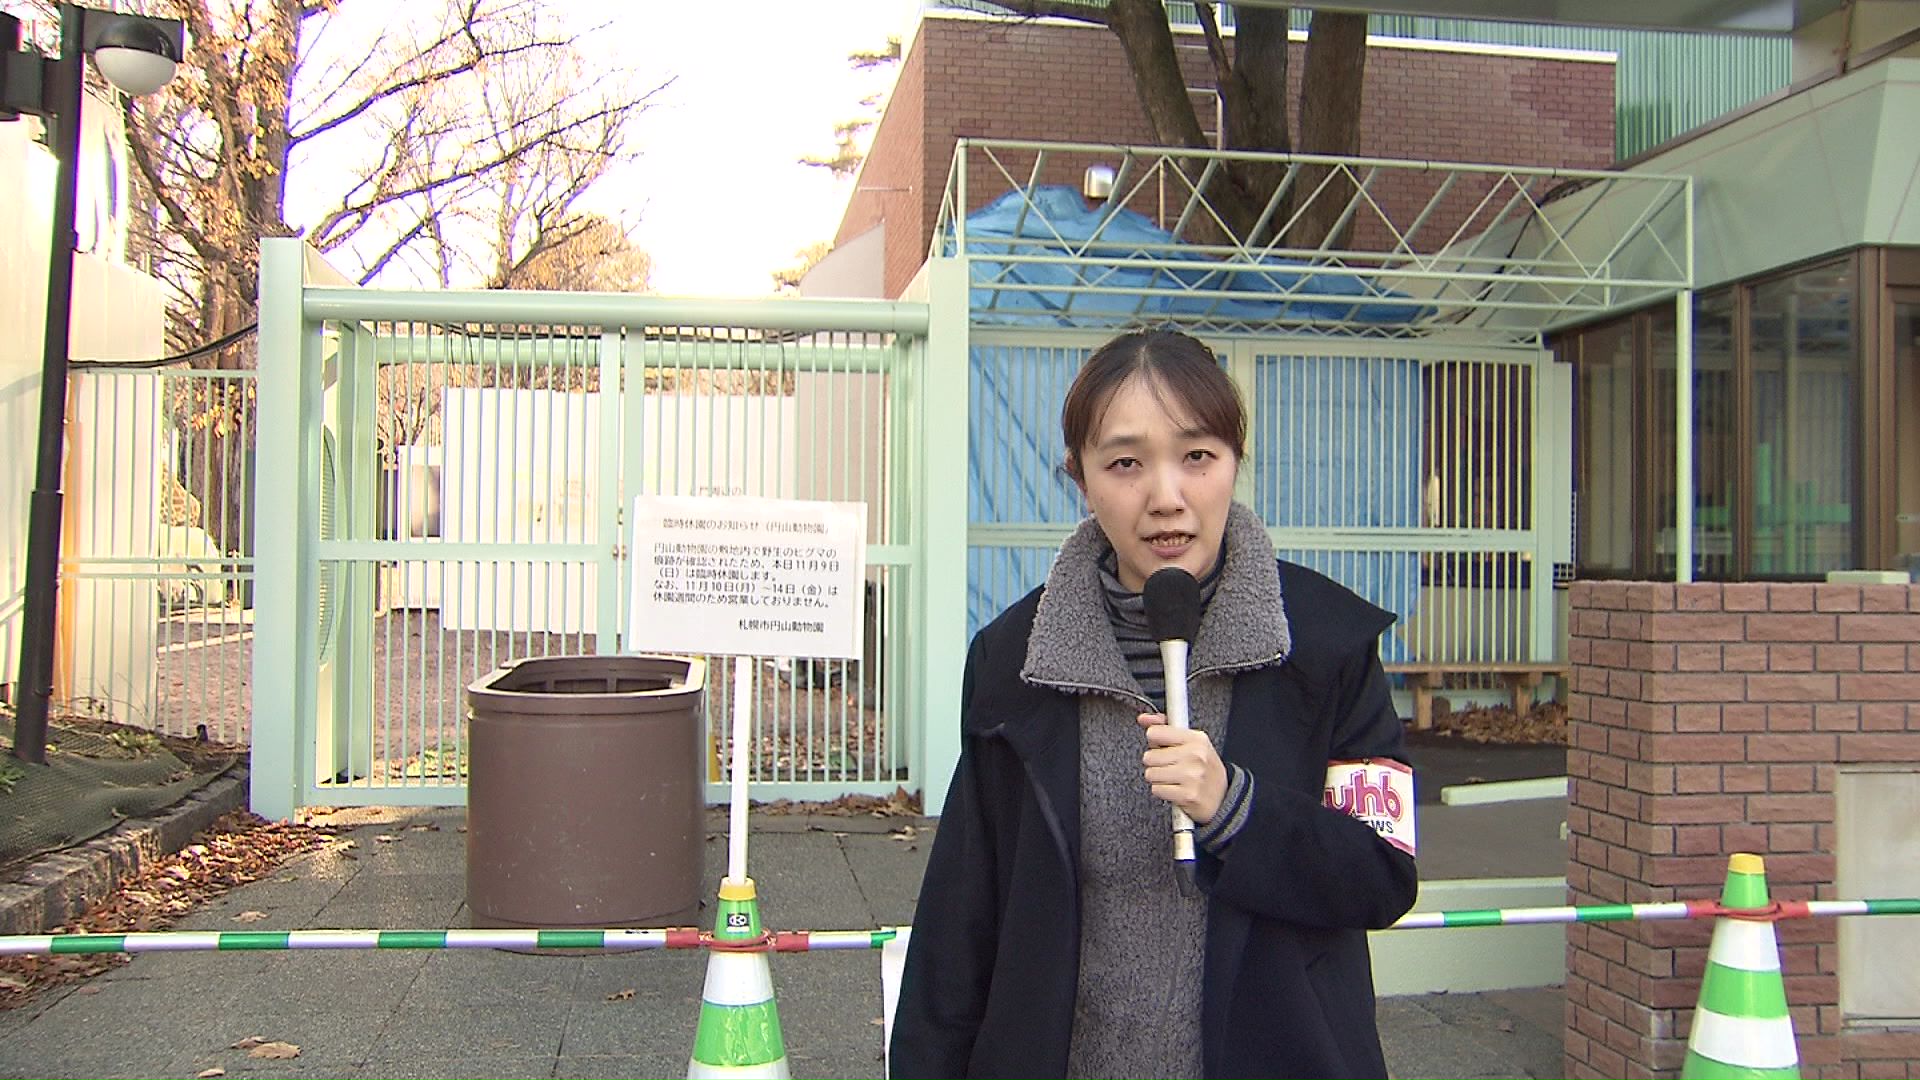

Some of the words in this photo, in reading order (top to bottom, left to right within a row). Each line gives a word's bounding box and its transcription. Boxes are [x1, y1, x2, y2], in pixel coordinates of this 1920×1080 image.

[739, 619, 824, 633] 札幌市円山動物園
[1323, 769, 1404, 822] uhb
